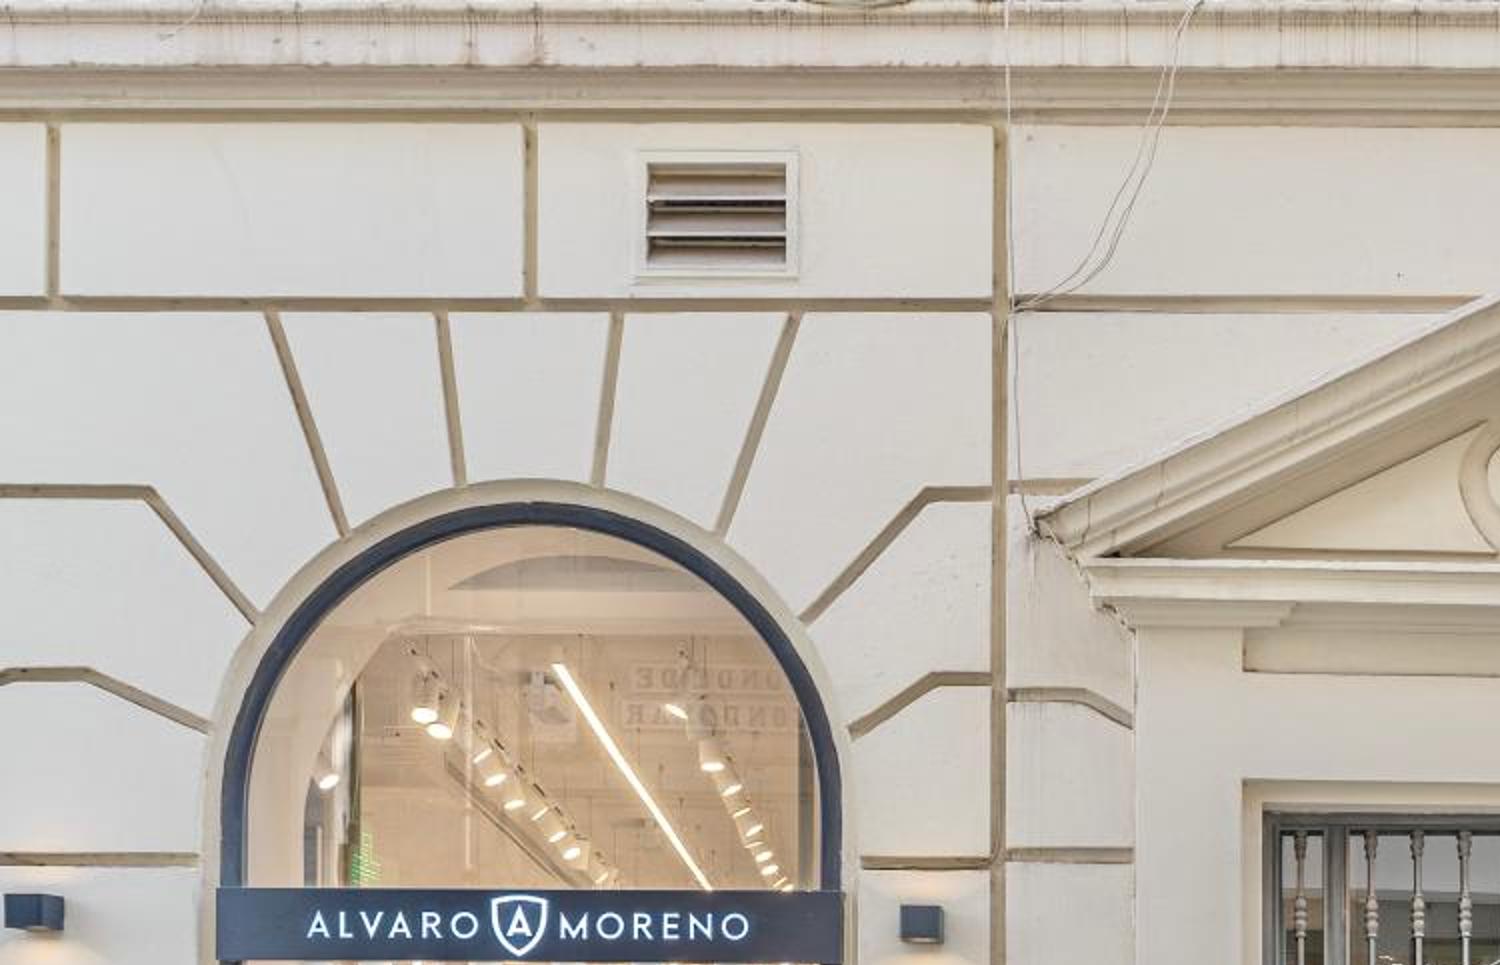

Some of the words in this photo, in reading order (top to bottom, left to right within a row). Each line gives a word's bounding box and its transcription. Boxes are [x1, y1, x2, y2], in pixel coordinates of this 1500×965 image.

[307, 910, 480, 940] ALVARO
[505, 903, 534, 938] A
[559, 912, 751, 941] MORENO
